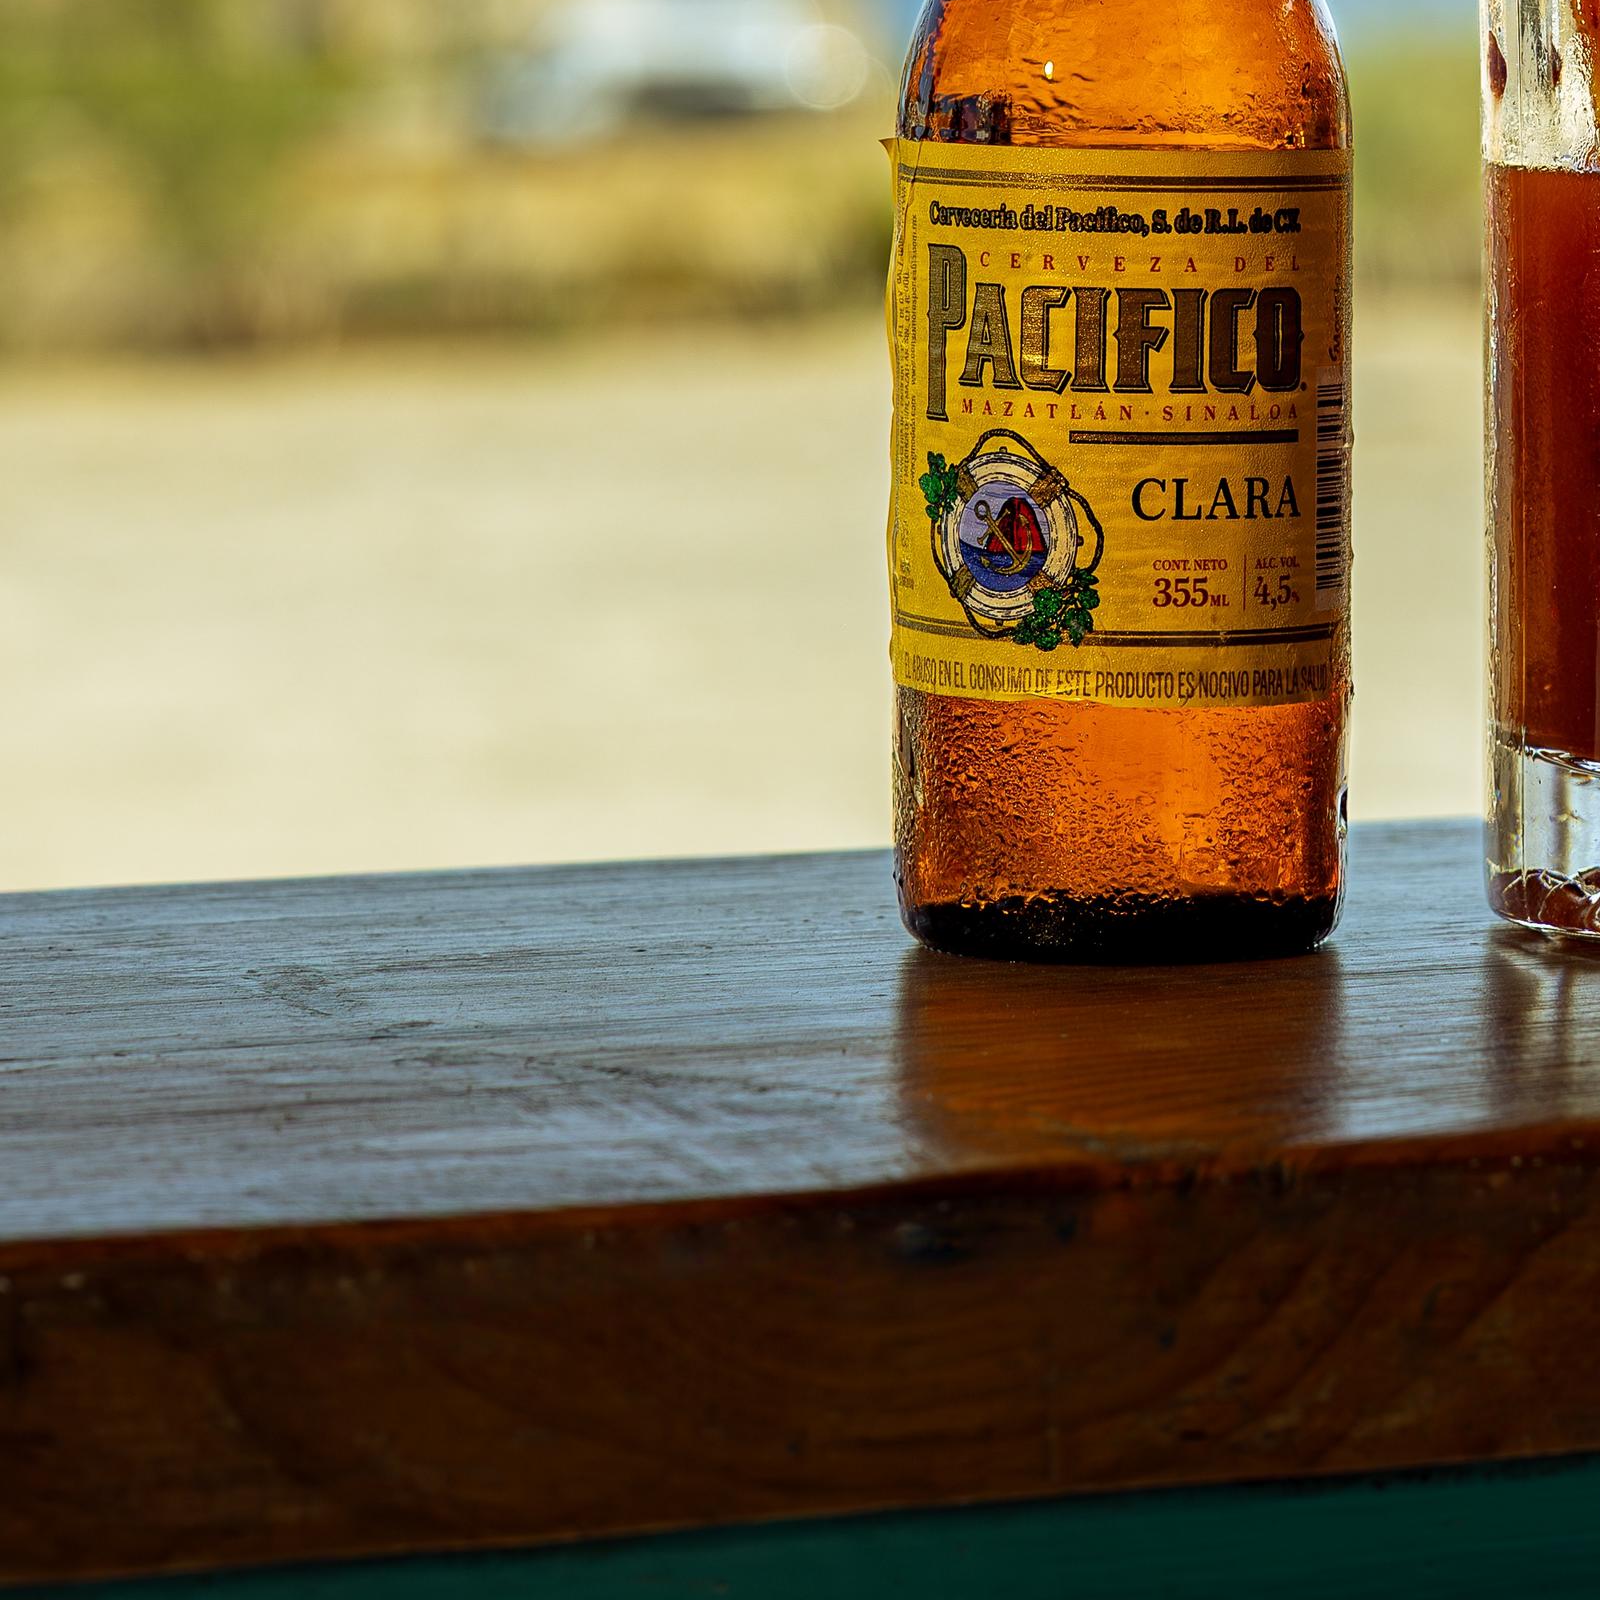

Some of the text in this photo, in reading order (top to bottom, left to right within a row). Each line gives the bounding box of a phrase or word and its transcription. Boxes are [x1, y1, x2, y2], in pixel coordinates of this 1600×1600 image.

[1019, 203, 1054, 232] del
[1151, 208, 1173, 234] S.
[1174, 206, 1203, 235] de
[1249, 206, 1273, 235] de
[980, 251, 1300, 273] CERVEZA DEL
[961, 397, 1299, 422] MAZATLÁN SINALOA
[1131, 475, 1301, 521] CLARA
[1152, 558, 1228, 571] CONT. NETO
[1254, 557, 1279, 570] ALC.
[904, 651, 912, 680] EL
[938, 659, 950, 687] EN
[953, 661, 967, 689] EL
[969, 663, 1032, 693] CONSUMO
[1055, 669, 1092, 697] ESTE
[1095, 671, 1174, 699] PRODUCTO
[1178, 670, 1194, 699] ES
[1198, 669, 1250, 699] NOCIVO
[1252, 668, 1284, 697] PARA
[1285, 666, 1299, 695] LA
[1300, 663, 1327, 694] SALUD
